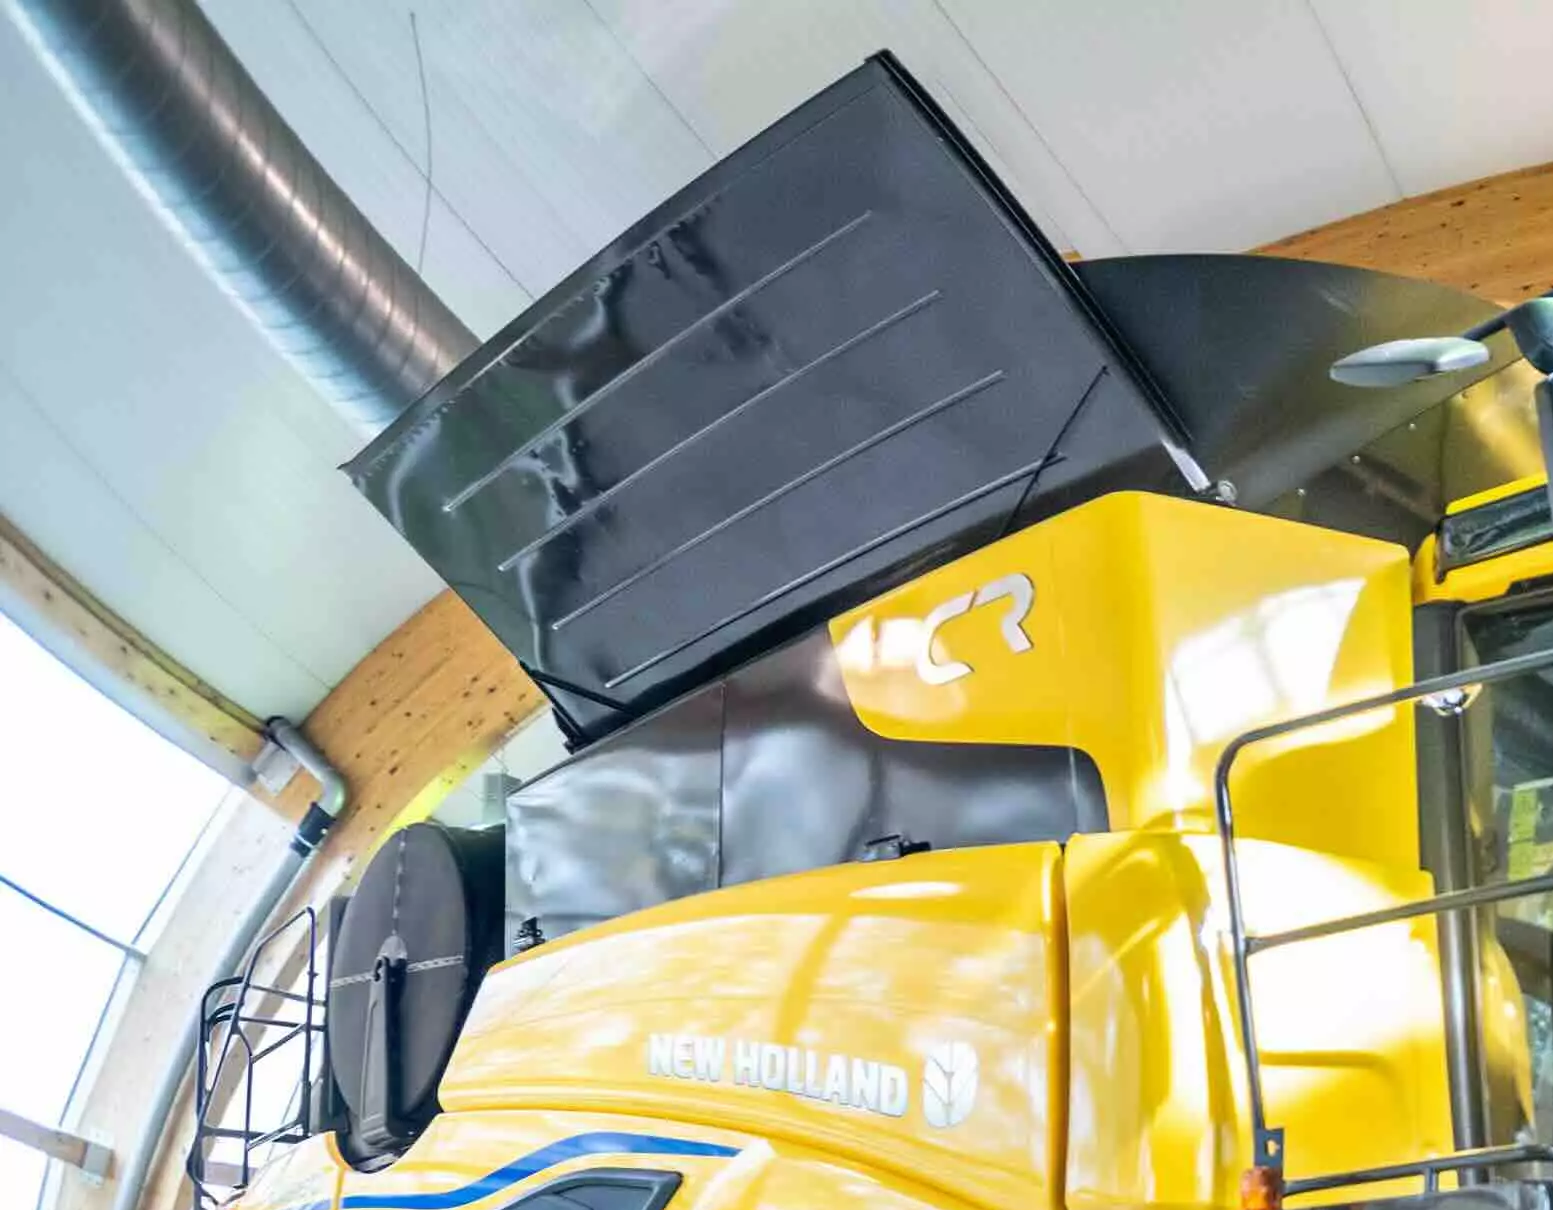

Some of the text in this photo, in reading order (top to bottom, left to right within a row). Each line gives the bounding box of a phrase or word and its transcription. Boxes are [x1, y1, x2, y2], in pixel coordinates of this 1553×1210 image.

[915, 572, 1034, 686] CR
[648, 1033, 908, 1118] NEW HOLLAND
